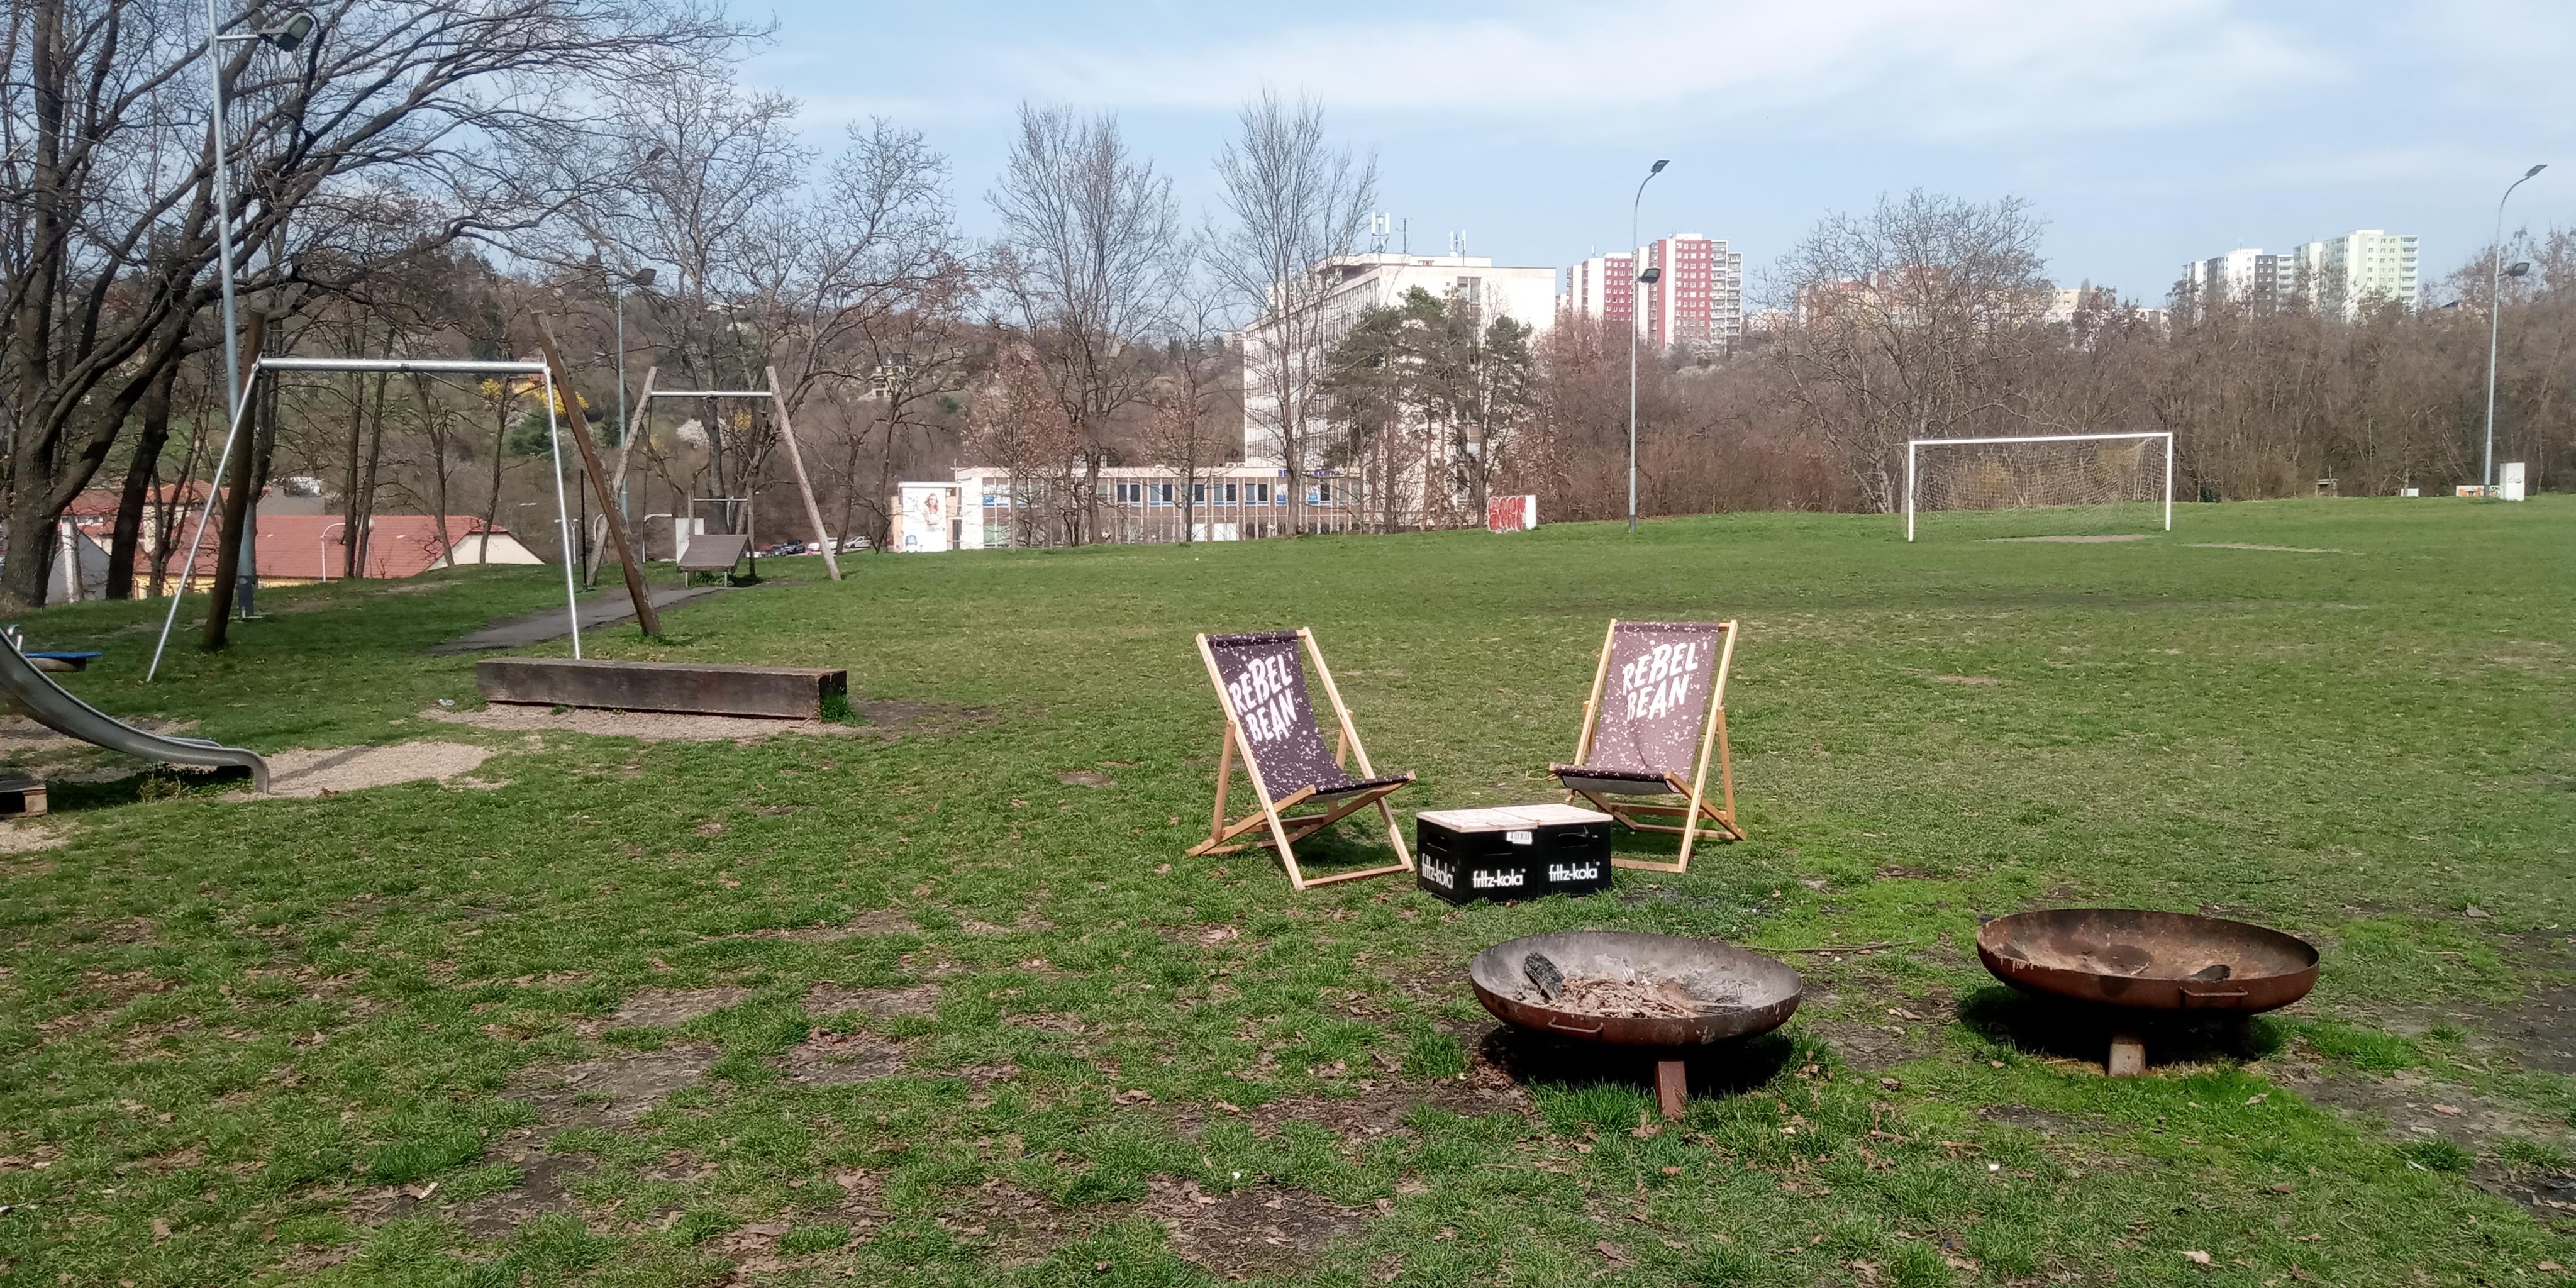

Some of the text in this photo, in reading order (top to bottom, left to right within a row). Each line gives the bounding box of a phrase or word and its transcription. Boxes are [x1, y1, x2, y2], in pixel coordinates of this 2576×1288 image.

[1228, 653, 1293, 716] REBEL
[1622, 642, 1698, 696] REBEL
[1245, 687, 1297, 742] BEAN
[1626, 673, 1690, 721] BEAN
